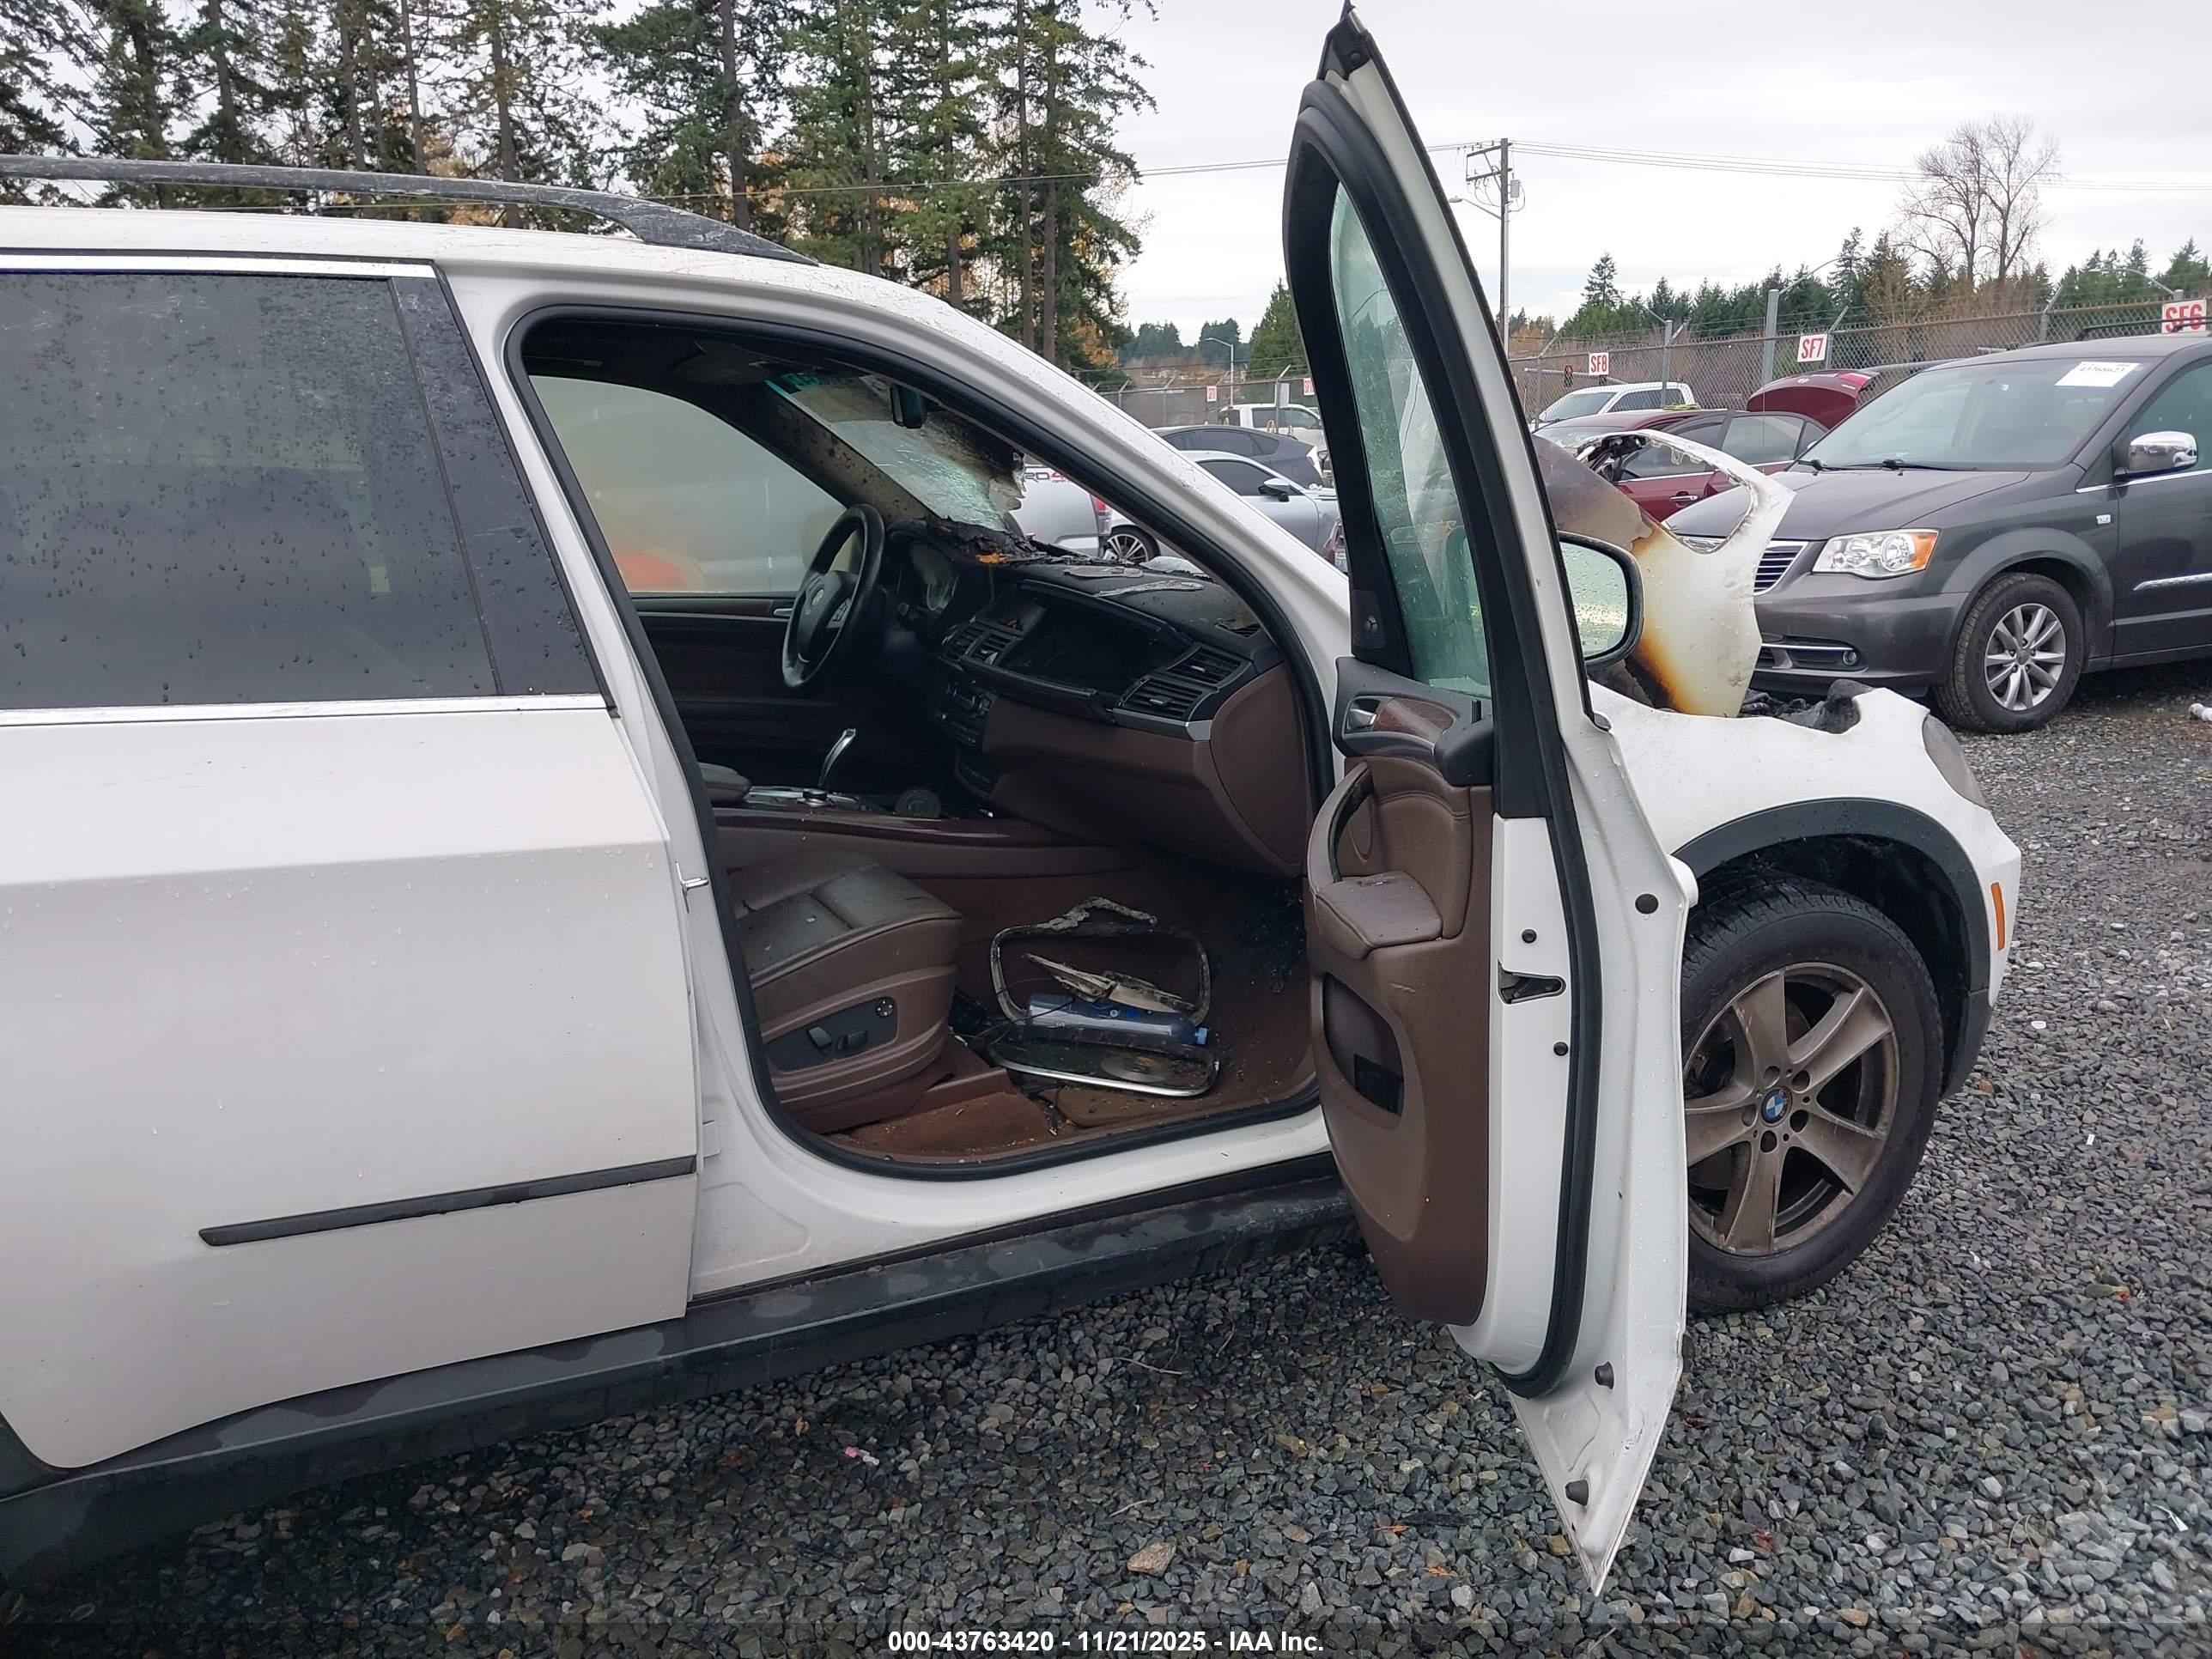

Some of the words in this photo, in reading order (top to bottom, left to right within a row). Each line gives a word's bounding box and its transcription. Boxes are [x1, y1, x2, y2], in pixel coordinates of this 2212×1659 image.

[2166, 303, 2202, 334] SF6
[1802, 337, 1825, 359] SF7
[1590, 354, 1607, 373] SF8
